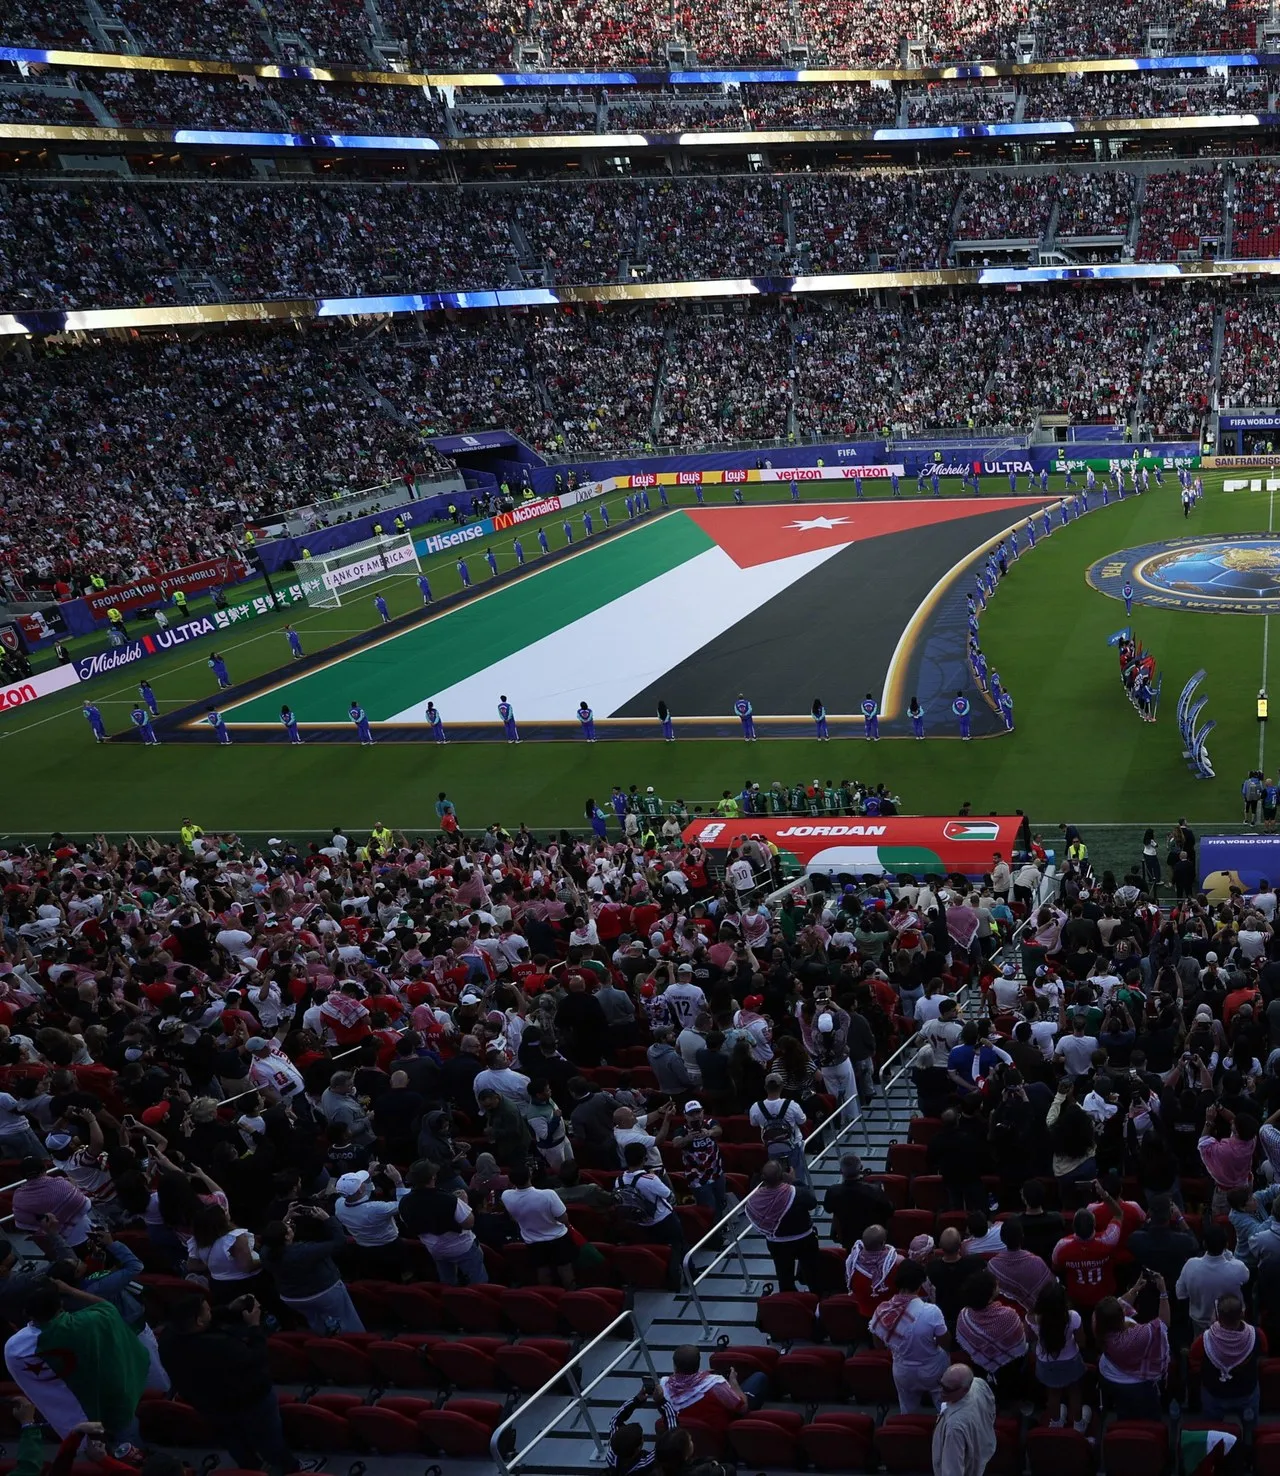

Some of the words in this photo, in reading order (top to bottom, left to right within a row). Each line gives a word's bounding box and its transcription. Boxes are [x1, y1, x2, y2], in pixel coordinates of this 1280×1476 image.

[1230, 418, 1248, 426] FIFA
[1249, 418, 1273, 426] WORLD
[837, 448, 857, 457] FIFA
[920, 462, 970, 476] Michelob
[985, 461, 1033, 473] ULTRA
[1215, 457, 1232, 467] SAN
[679, 471, 701, 484] Lay's
[725, 469, 746, 482] Lay's
[776, 468, 822, 480] verizon
[842, 467, 889, 479] verizon
[632, 474, 655, 487] Lay's
[575, 487, 593, 503] Dove
[400, 511, 413, 522] IFA
[512, 498, 561, 524] McDonald's
[426, 524, 484, 554] Hisense
[353, 564, 366, 576] OF
[1102, 562, 1127, 579] FIFA
[92, 592, 120, 609] FROM
[120, 583, 156, 602] JORAN
[169, 575, 186, 588] THE
[187, 568, 216, 584] WORLD
[1142, 595, 1182, 606] FIFA
[1186, 601, 1263, 610] WORLD
[227, 603, 250, 623] 蒙牛
[80, 643, 142, 680] Michelob
[156, 617, 215, 648] ULTRA
[776, 826, 887, 837] JORDAN
[736, 868, 748, 880] 10
[675, 1001, 692, 1016] 12
[692, 1138, 715, 1149] USA
[1076, 1267, 1102, 1286] 10
